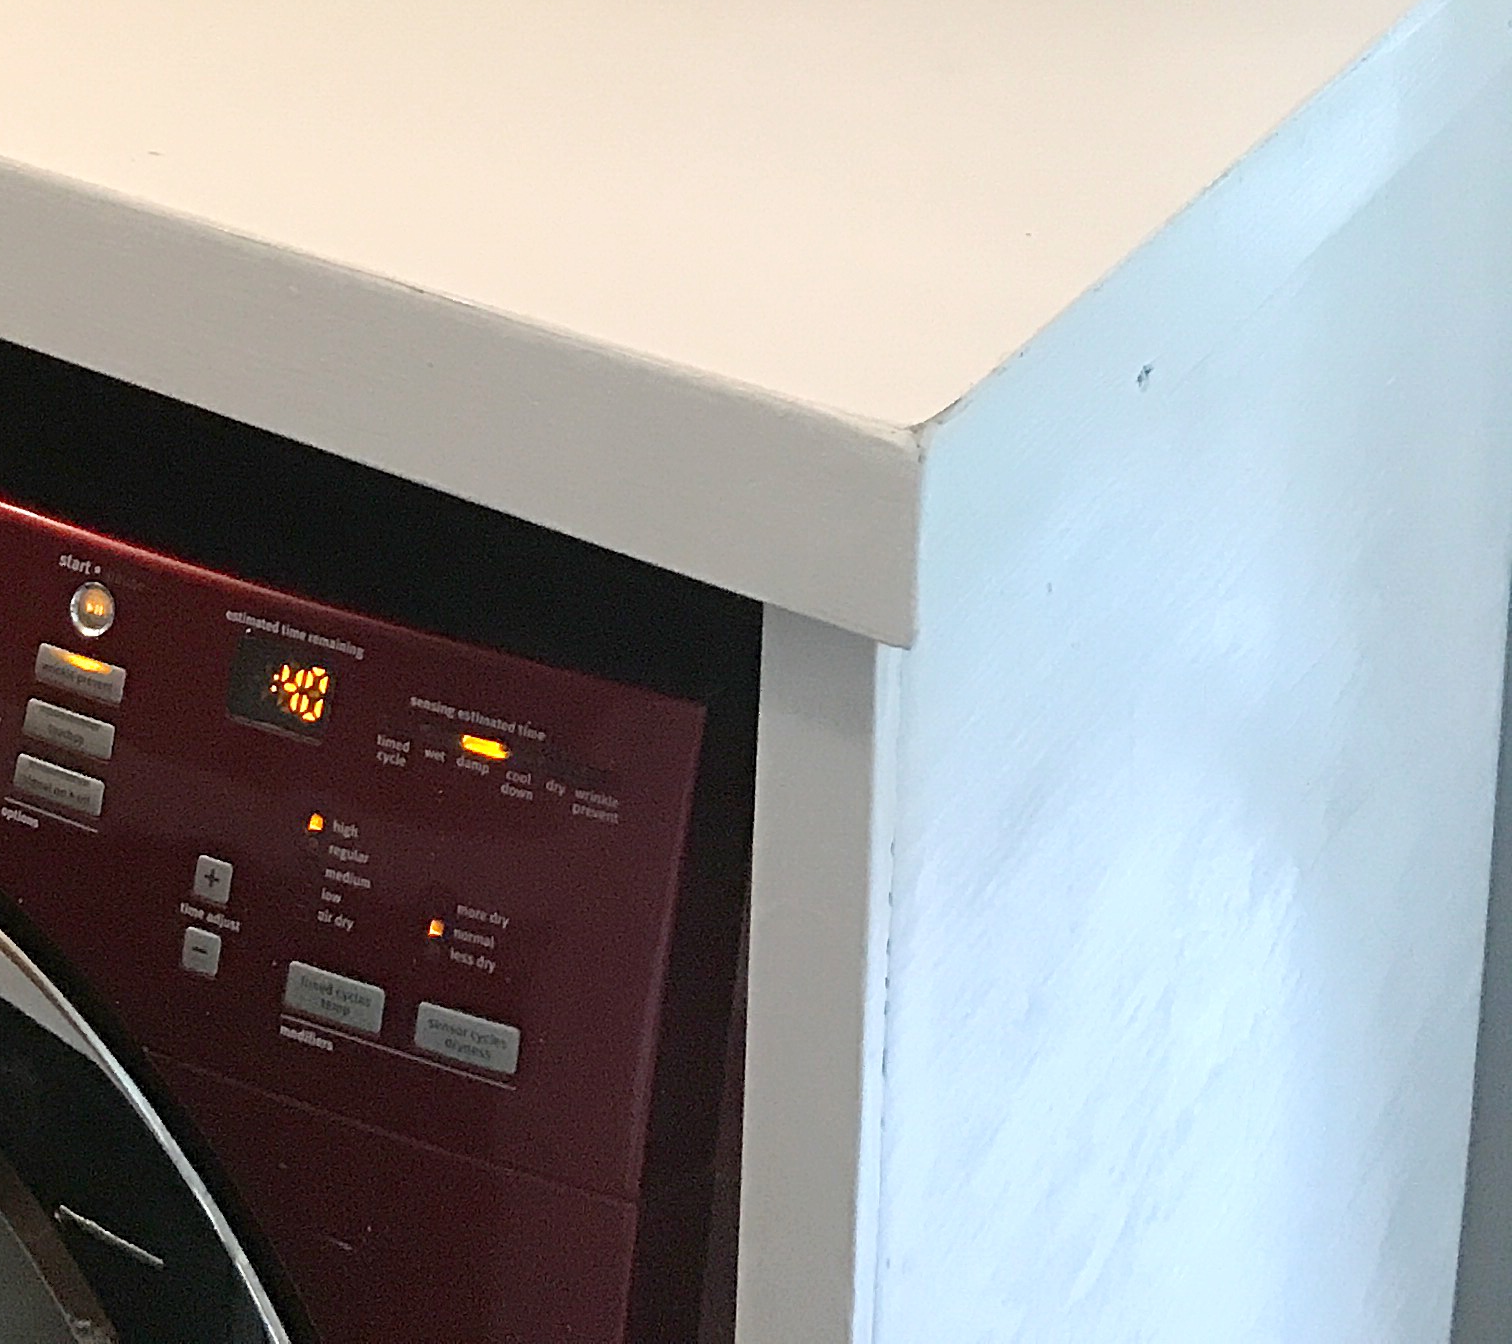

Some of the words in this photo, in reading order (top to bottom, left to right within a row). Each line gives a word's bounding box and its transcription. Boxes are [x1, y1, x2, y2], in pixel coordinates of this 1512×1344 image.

[58, 554, 92, 575] start
[225, 610, 280, 634] estimated
[281, 624, 307, 641] time
[308, 633, 365, 660] remaining
[410, 696, 456, 719] sensing
[457, 709, 516, 733] estimated
[518, 723, 546, 742] time
[377, 733, 410, 753] timed
[376, 750, 407, 767] cycle
[424, 747, 446, 763] wet
[456, 755, 489, 776] damp
[505, 769, 532, 785] cool
[500, 783, 534, 801] down
[545, 779, 566, 797] dry
[1, 807, 39, 828] options
[332, 819, 359, 839] high
[328, 844, 369, 864] regular
[324, 867, 371, 889] medium
[321, 888, 342, 904] low
[180, 902, 205, 920] time
[206, 912, 241, 933] adjust
[317, 909, 333, 923] air
[334, 913, 355, 932] dry
[457, 904, 487, 922] more
[489, 911, 510, 929] dry
[453, 928, 494, 949] normal
[450, 947, 474, 966] less
[476, 956, 496, 975] dry
[279, 1024, 334, 1051] modifiers
[427, 1018, 468, 1039] sensor
[470, 1029, 508, 1050] cycles
[444, 1038, 492, 1060] dryness
